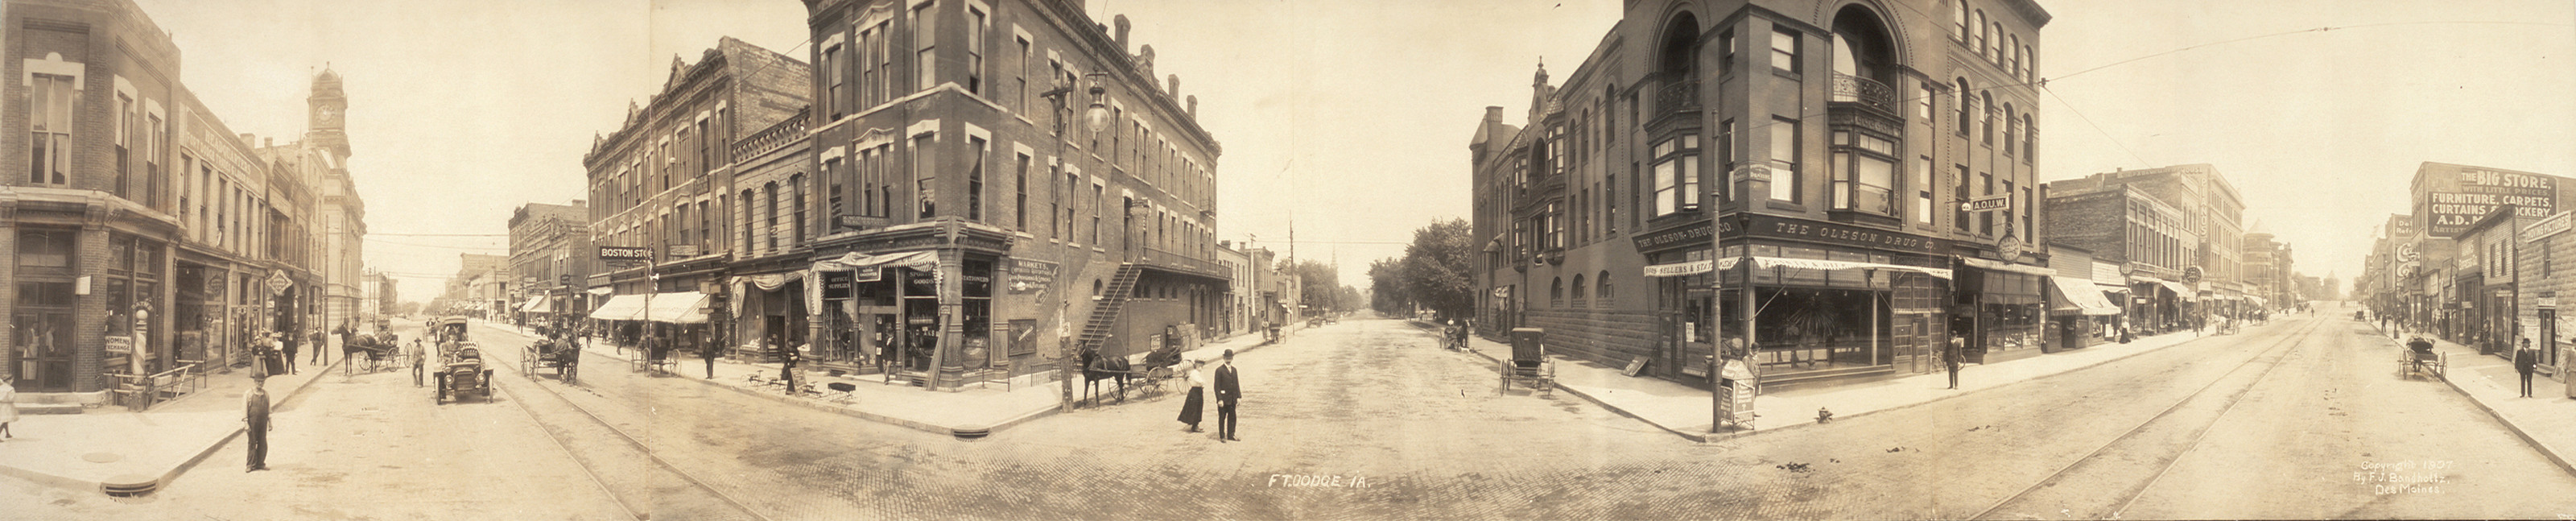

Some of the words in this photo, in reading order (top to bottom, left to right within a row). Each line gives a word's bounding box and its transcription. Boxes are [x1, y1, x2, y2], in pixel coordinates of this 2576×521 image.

[2462, 172, 2477, 182] THE
[2477, 170, 2500, 186] BIG
[2462, 185, 2483, 193] WITH
[2486, 186, 2511, 195] LITTLE
[1974, 199, 2005, 209] A.O.U.W.
[2432, 204, 2487, 216] CURTAINS
[2544, 215, 2570, 234] PICTURES
[1637, 238, 1653, 248] THE
[1653, 231, 1684, 245] OLESON
[1687, 225, 1713, 238] DRUG
[1777, 222, 1810, 235] THE
[1820, 227, 1878, 243] OLESON
[1885, 235, 1917, 247] DRUG
[601, 248, 633, 258] BOSTON
